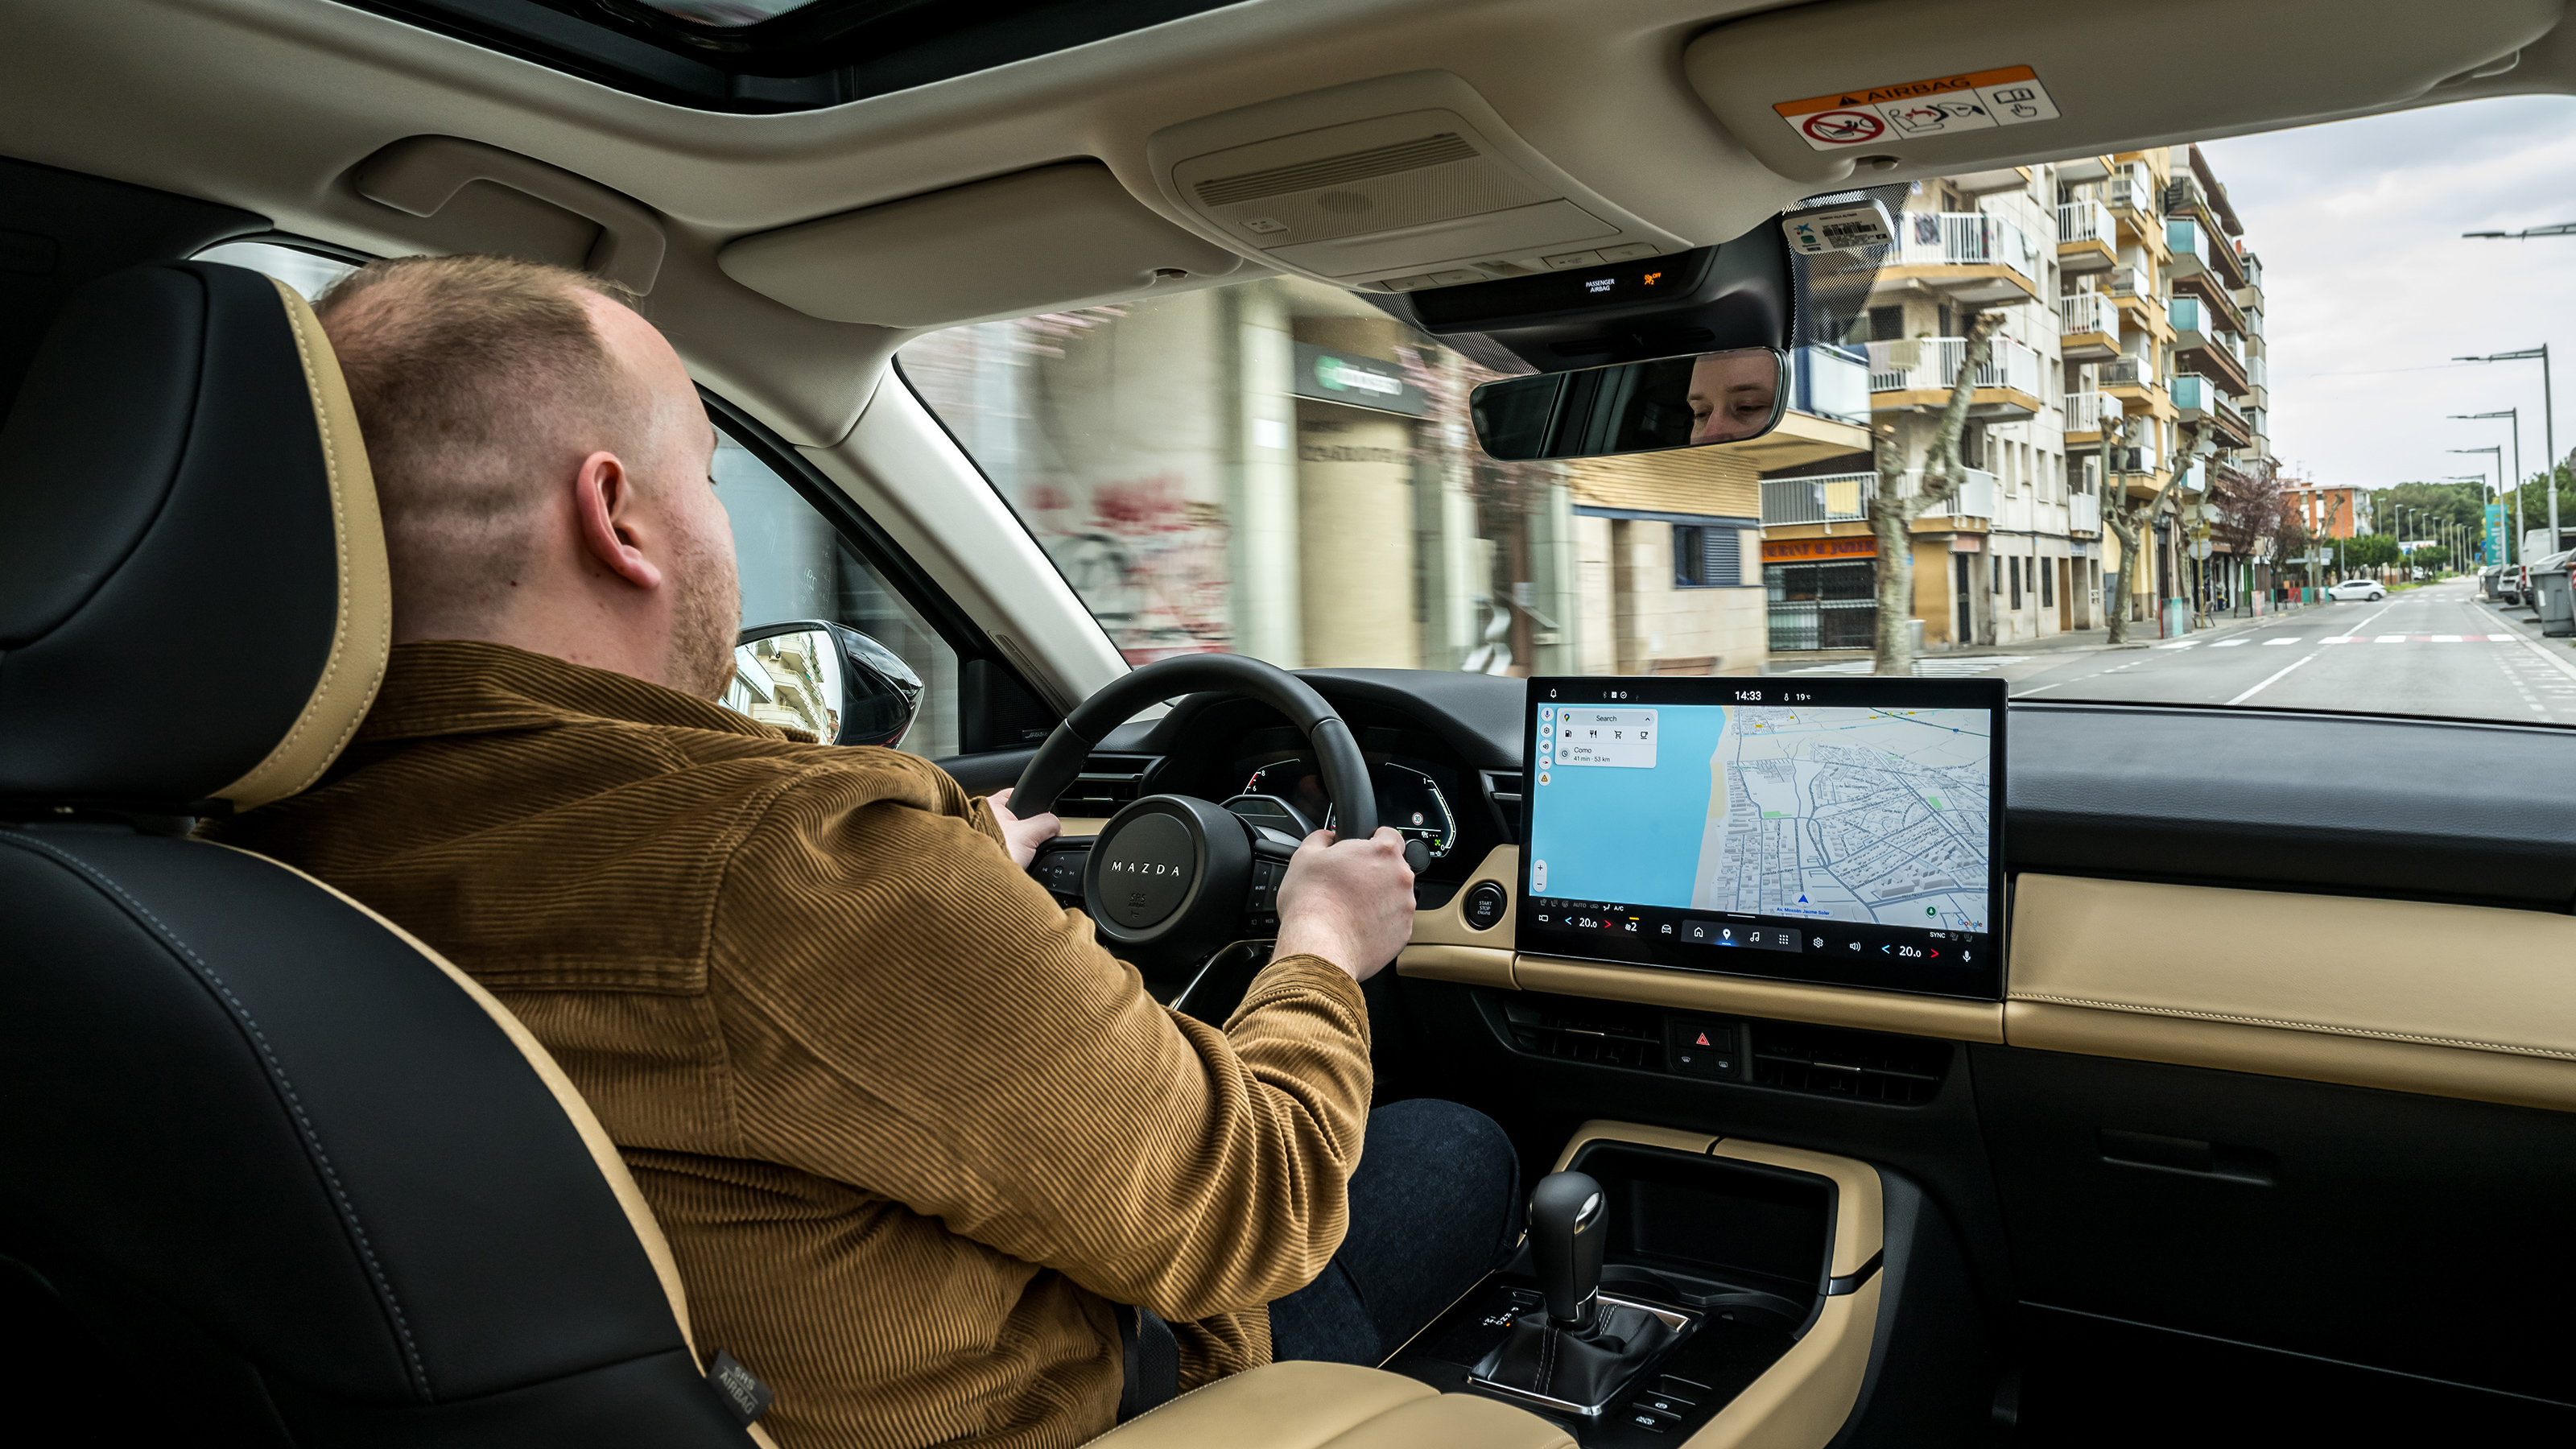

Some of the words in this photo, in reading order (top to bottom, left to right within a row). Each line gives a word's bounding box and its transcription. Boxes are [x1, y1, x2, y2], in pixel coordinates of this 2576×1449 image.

[1868, 76, 1971, 102] AIRBAG
[1586, 279, 1615, 287] PASSENGER
[1590, 285, 1610, 293] AIRBAG
[1735, 691, 1761, 700] 14:33
[1111, 861, 1179, 877] MAZDA
[1131, 893, 1146, 902] SRS
[1579, 918, 1597, 928] 20.0
[1631, 922, 1637, 931] 2
[1957, 919, 1983, 929] Google
[1899, 945, 1922, 958] 20.0
[733, 1366, 756, 1391] SRS
[719, 1371, 755, 1415] AIRBAG
